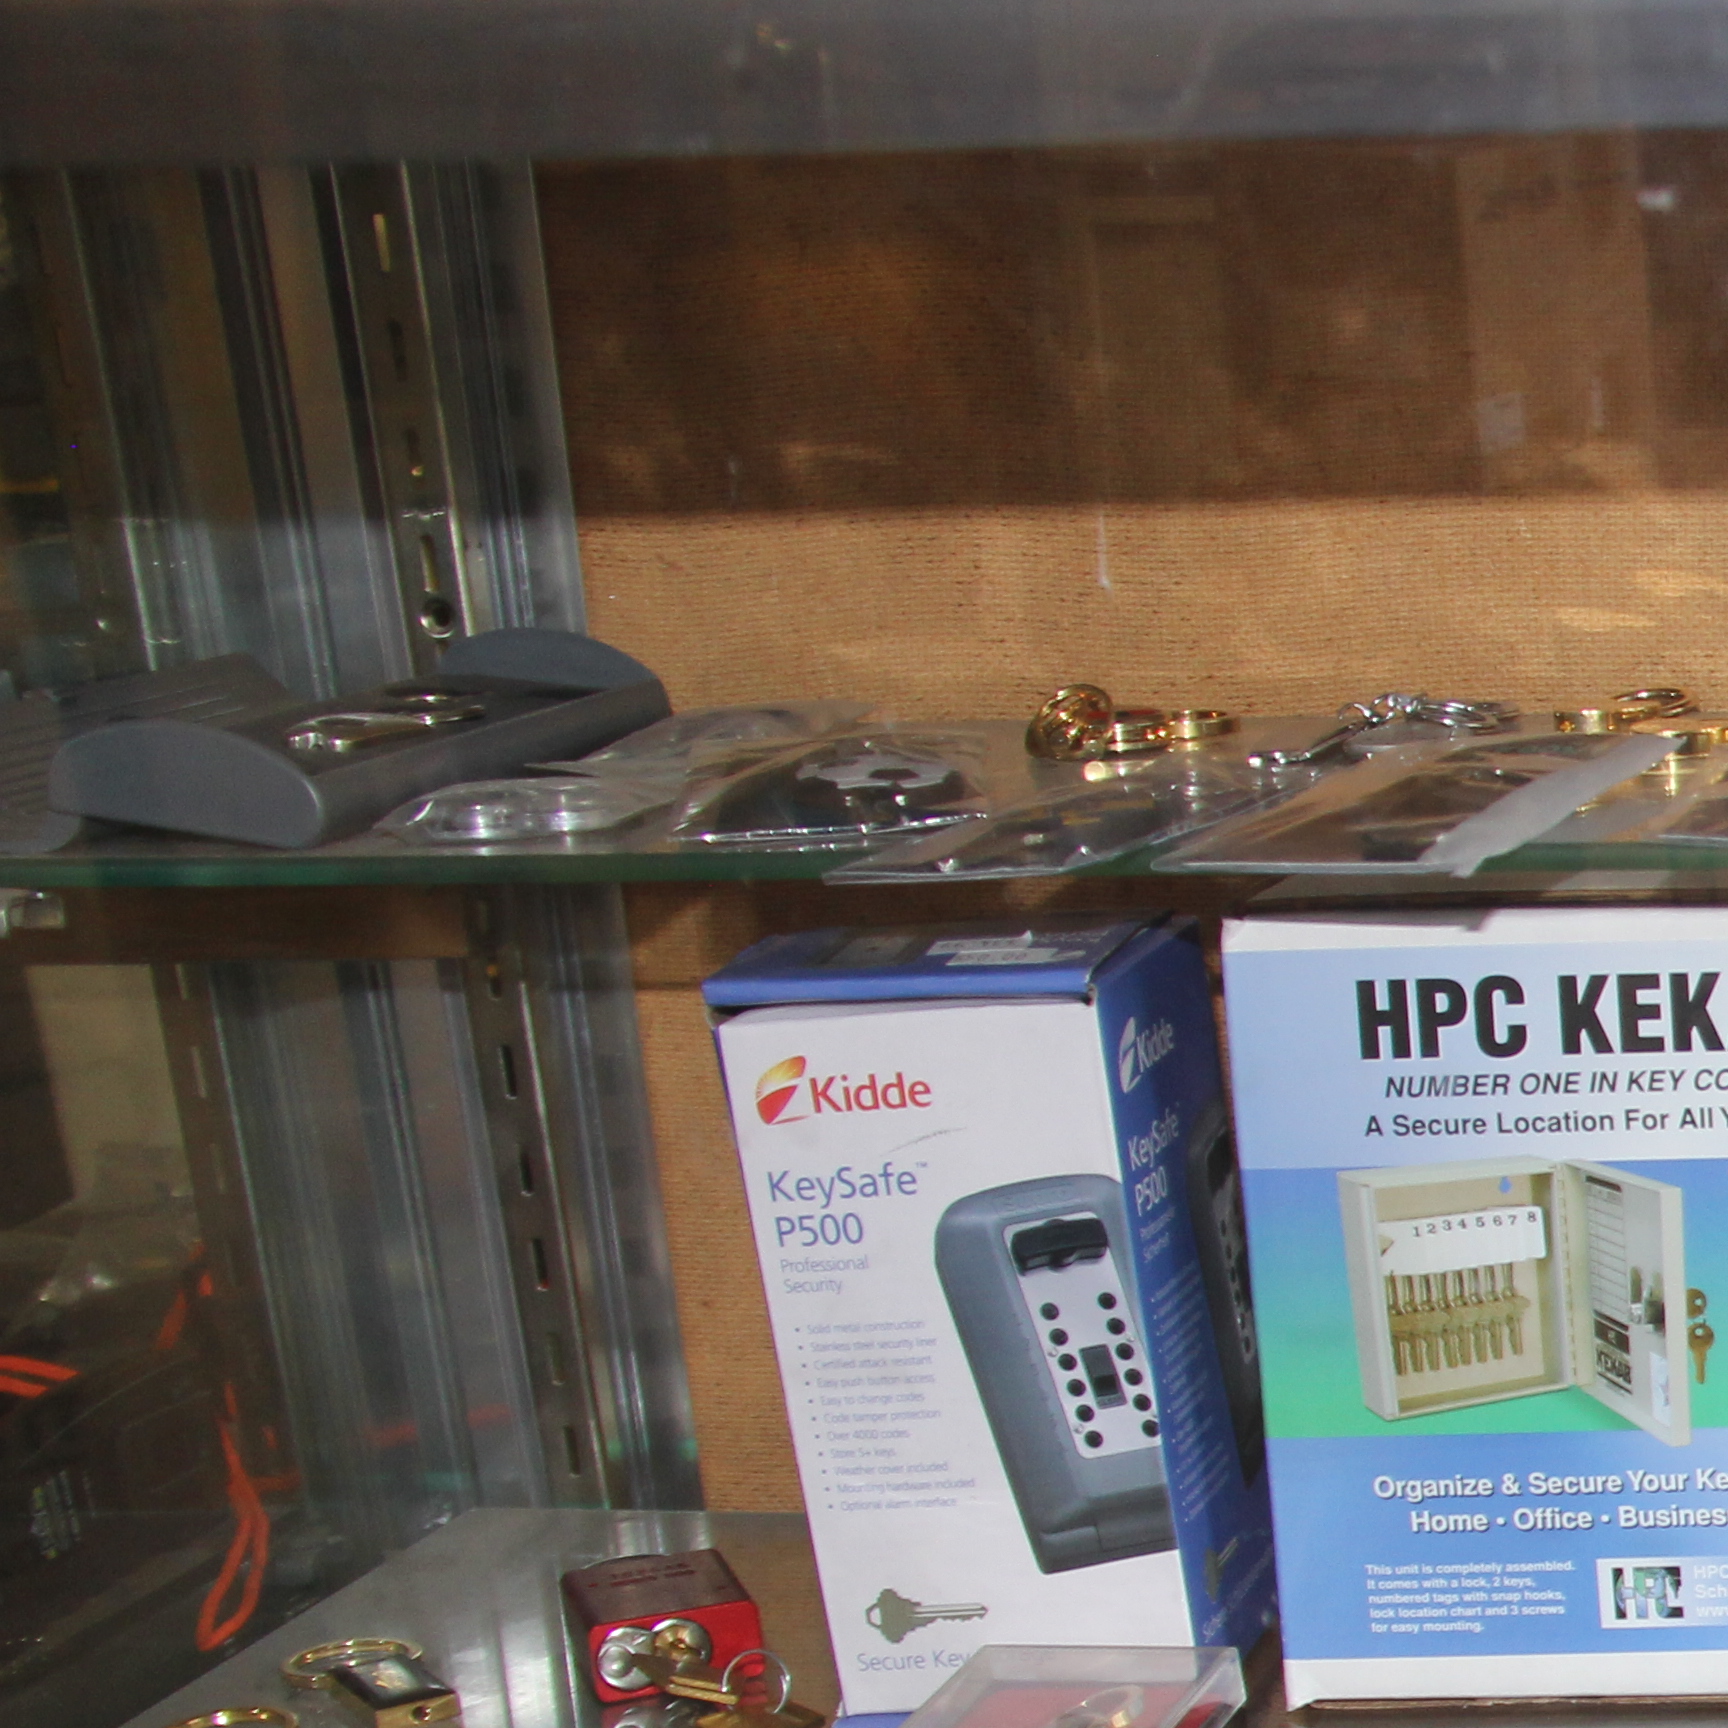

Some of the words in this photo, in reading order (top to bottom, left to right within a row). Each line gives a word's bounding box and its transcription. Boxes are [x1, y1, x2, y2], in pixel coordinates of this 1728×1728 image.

[1356, 975, 1528, 1060] HPC
[1136, 1018, 1174, 1073] Kidde
[810, 1072, 933, 1114] Kidde
[1386, 1074, 1510, 1098] NUMBER
[1520, 1072, 1581, 1095] ONE
[1590, 1071, 1618, 1093] IN
[1627, 1069, 1686, 1092] KEY
[1365, 1115, 1383, 1136] A
[1392, 1114, 1486, 1136] Secure
[1497, 1110, 1614, 1134] Location
[1624, 1108, 1669, 1130] For
[1680, 1107, 1714, 1129] All
[1128, 1107, 1180, 1171] KeySafe
[1135, 1165, 1168, 1216] P500
[775, 1212, 864, 1247] P500
[780, 1255, 869, 1273] Professional
[784, 1279, 842, 1294] Security
[1373, 1475, 1494, 1502] Organize
[1502, 1474, 1521, 1496] &
[1528, 1472, 1623, 1496] Secure
[1627, 1469, 1688, 1493] Your
[1410, 1510, 1489, 1533] Home
[1513, 1508, 1593, 1531] Office
[1365, 1565, 1392, 1575] This
[1396, 1564, 1417, 1574] unit
[1422, 1564, 1432, 1574] is
[1436, 1562, 1501, 1576] completely
[1506, 1561, 1575, 1572] assembled.
[857, 1653, 925, 1672] Secure
